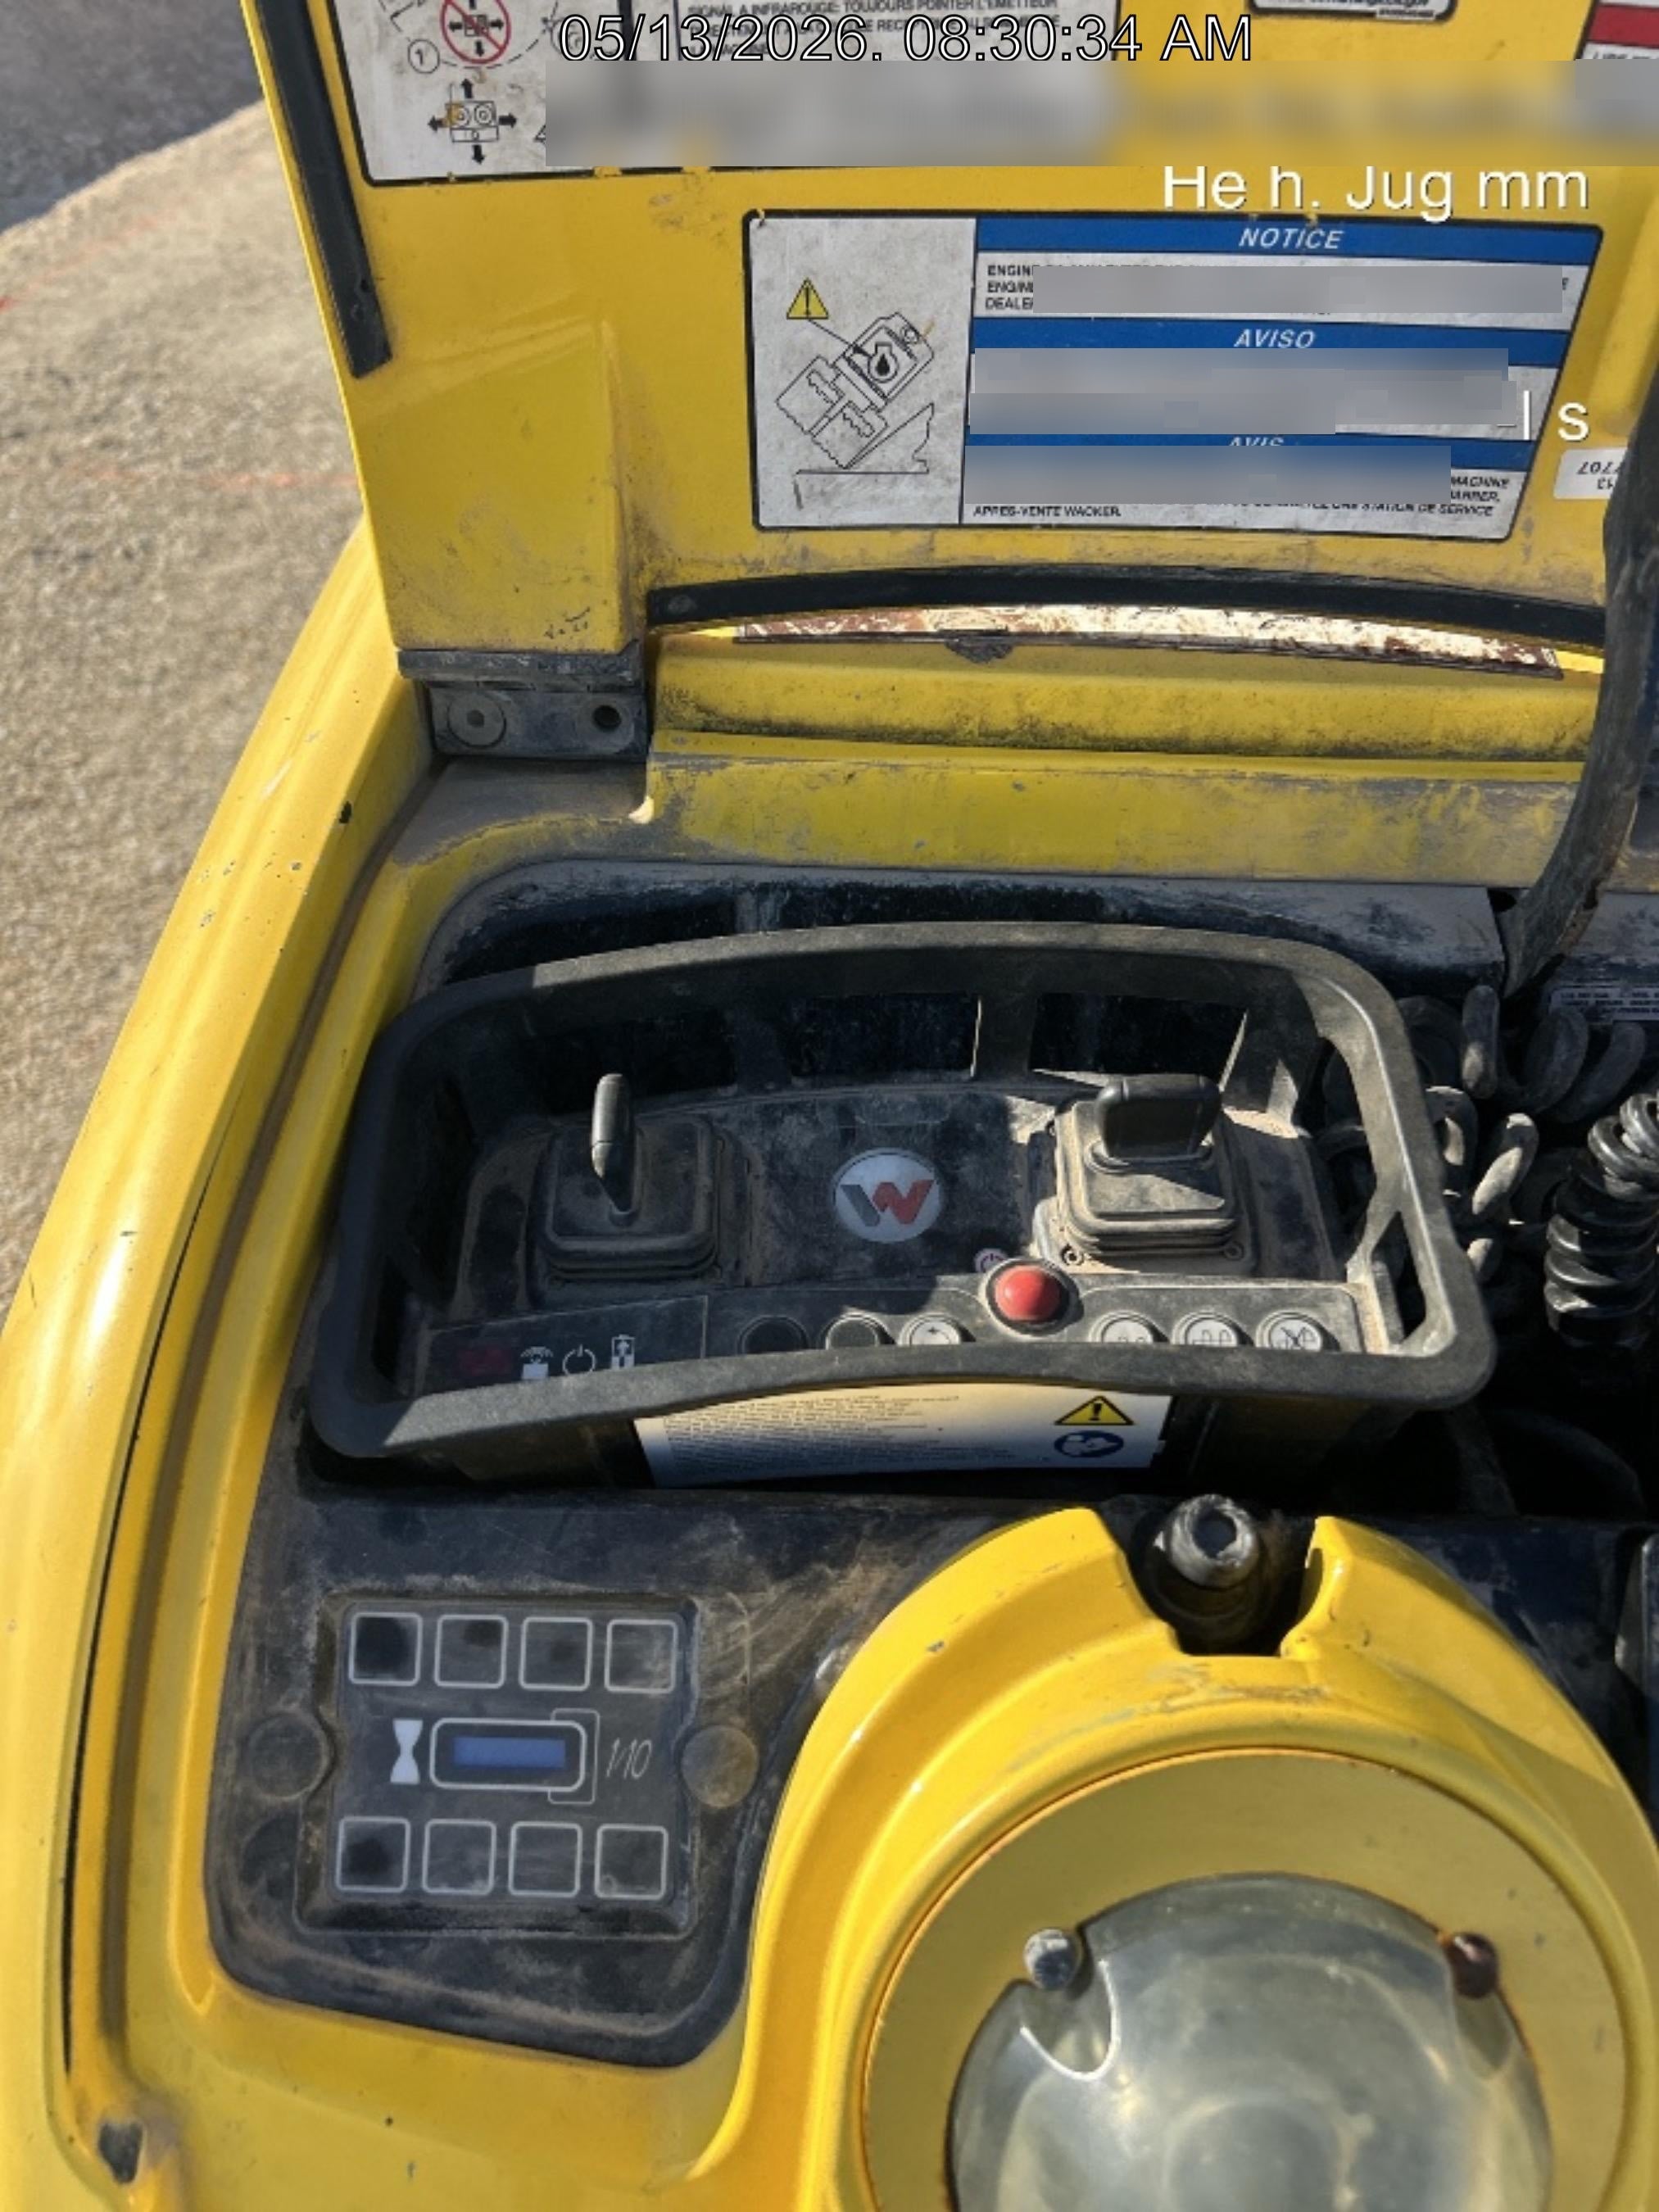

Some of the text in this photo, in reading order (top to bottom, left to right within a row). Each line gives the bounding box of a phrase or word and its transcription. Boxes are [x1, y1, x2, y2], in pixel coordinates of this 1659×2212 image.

[1238, 227, 1344, 250] NOTICE
[988, 265, 1033, 276] ENGIN
[985, 297, 1033, 310] DEALE
[1232, 328, 1316, 348] AVISO
[1576, 460, 1620, 476] 707
